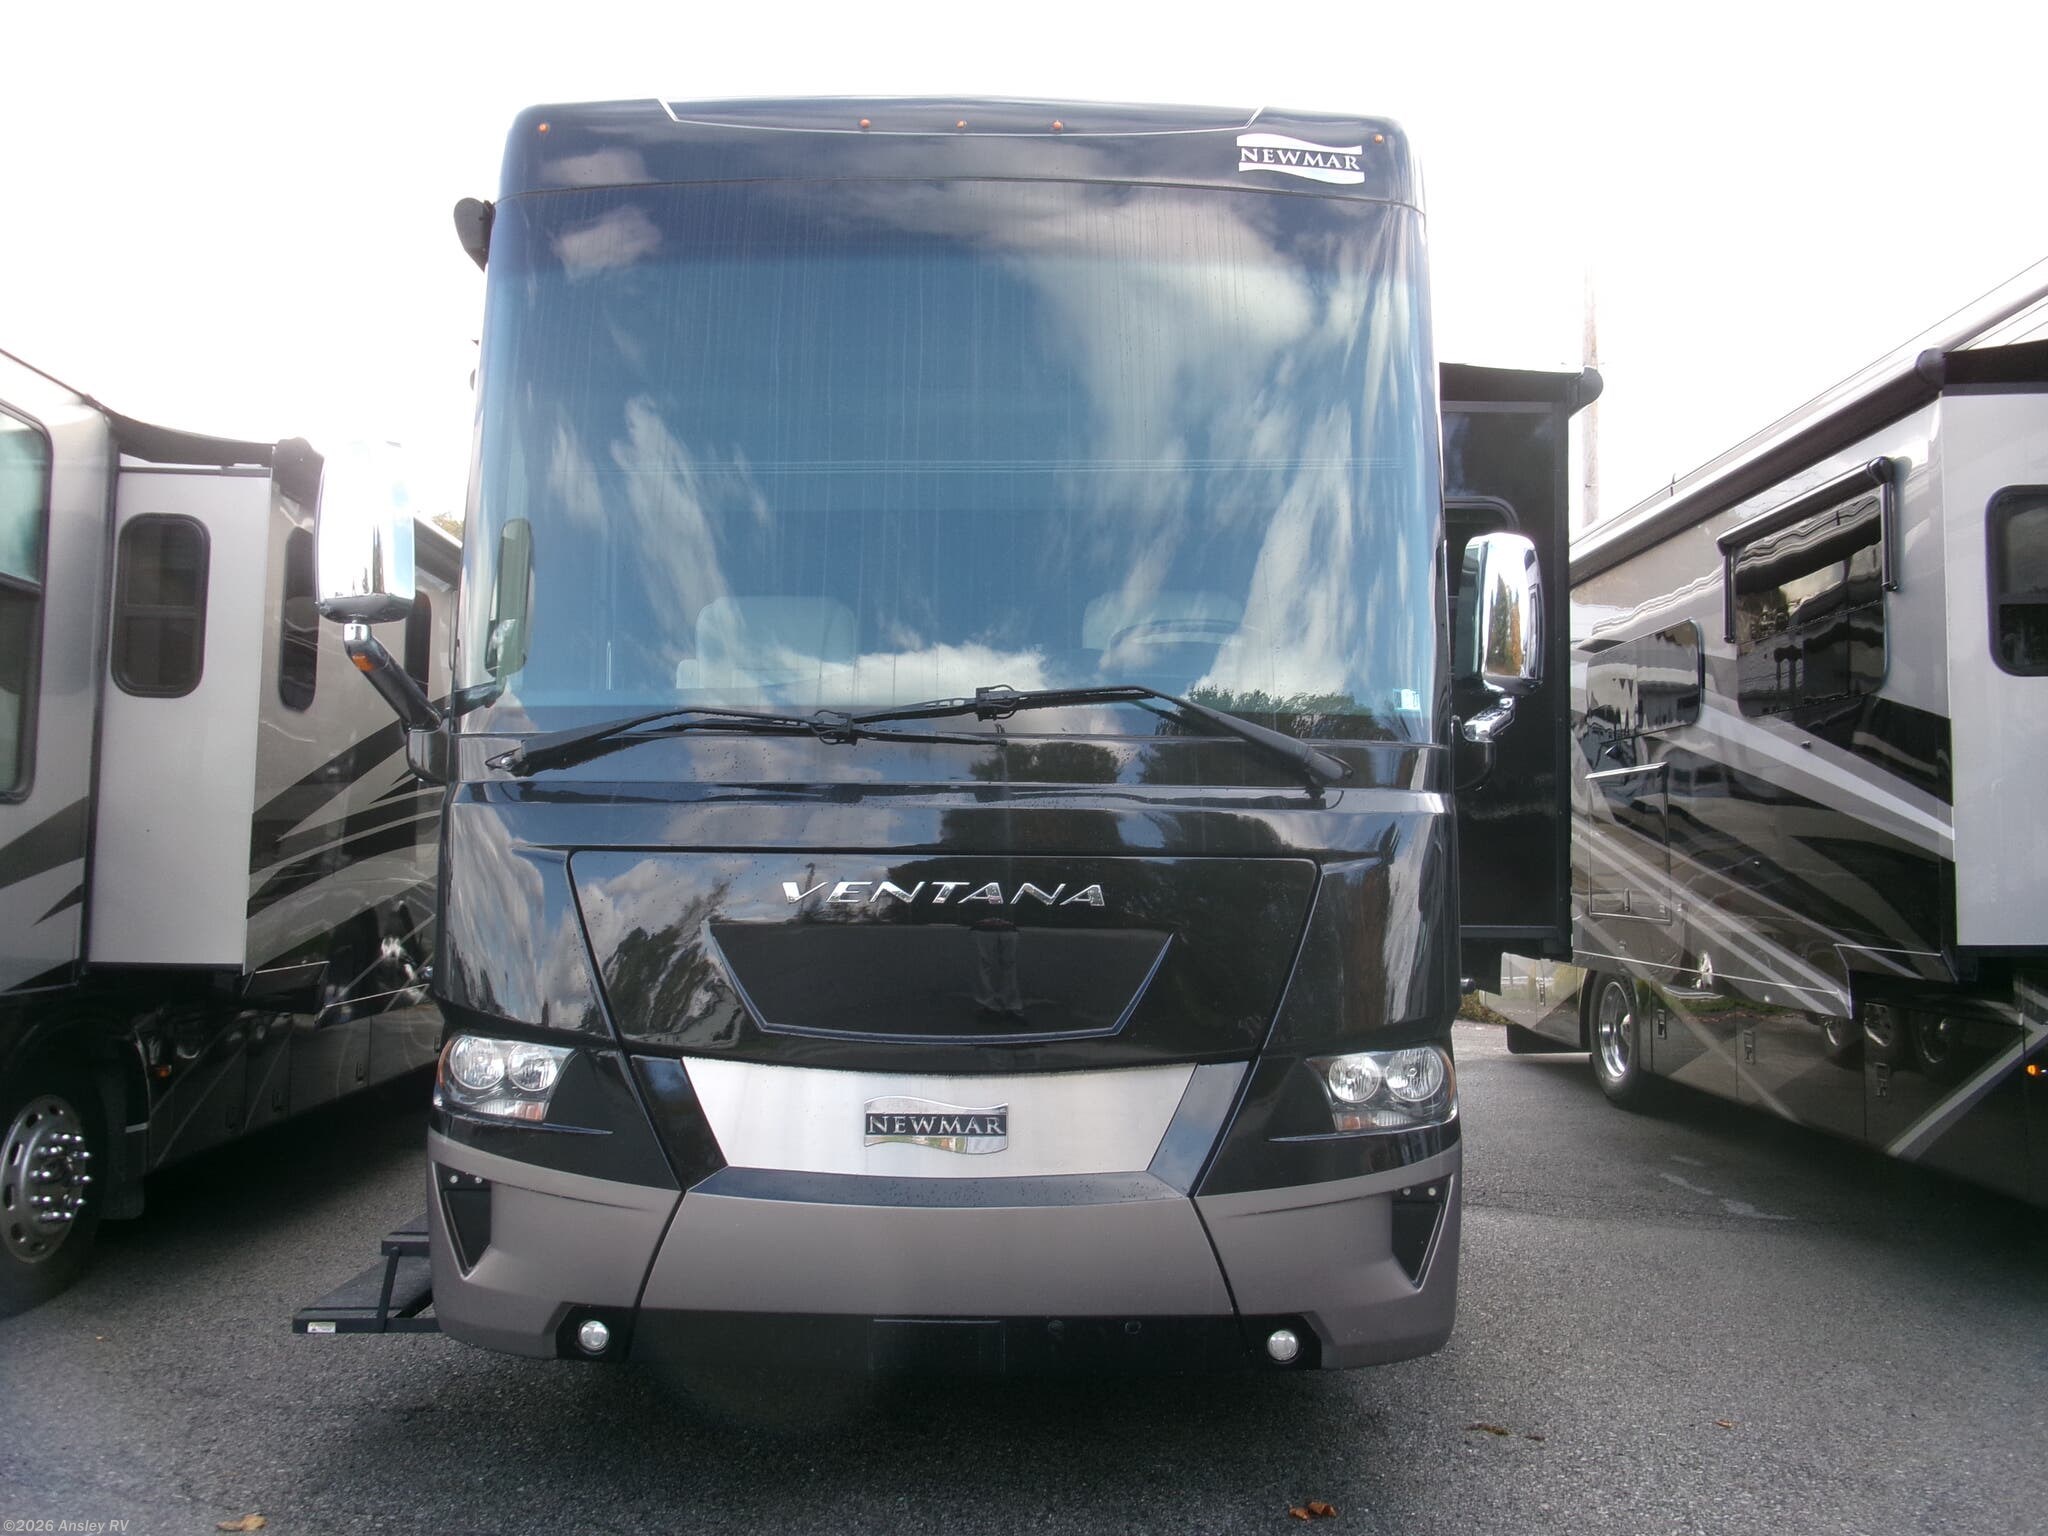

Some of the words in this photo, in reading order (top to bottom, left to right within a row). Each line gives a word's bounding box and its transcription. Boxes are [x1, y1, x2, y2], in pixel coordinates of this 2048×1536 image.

[1240, 148, 1360, 170] NEWMAR
[782, 881, 1105, 906] VENTANA
[867, 1115, 1005, 1134] NEWMAR
